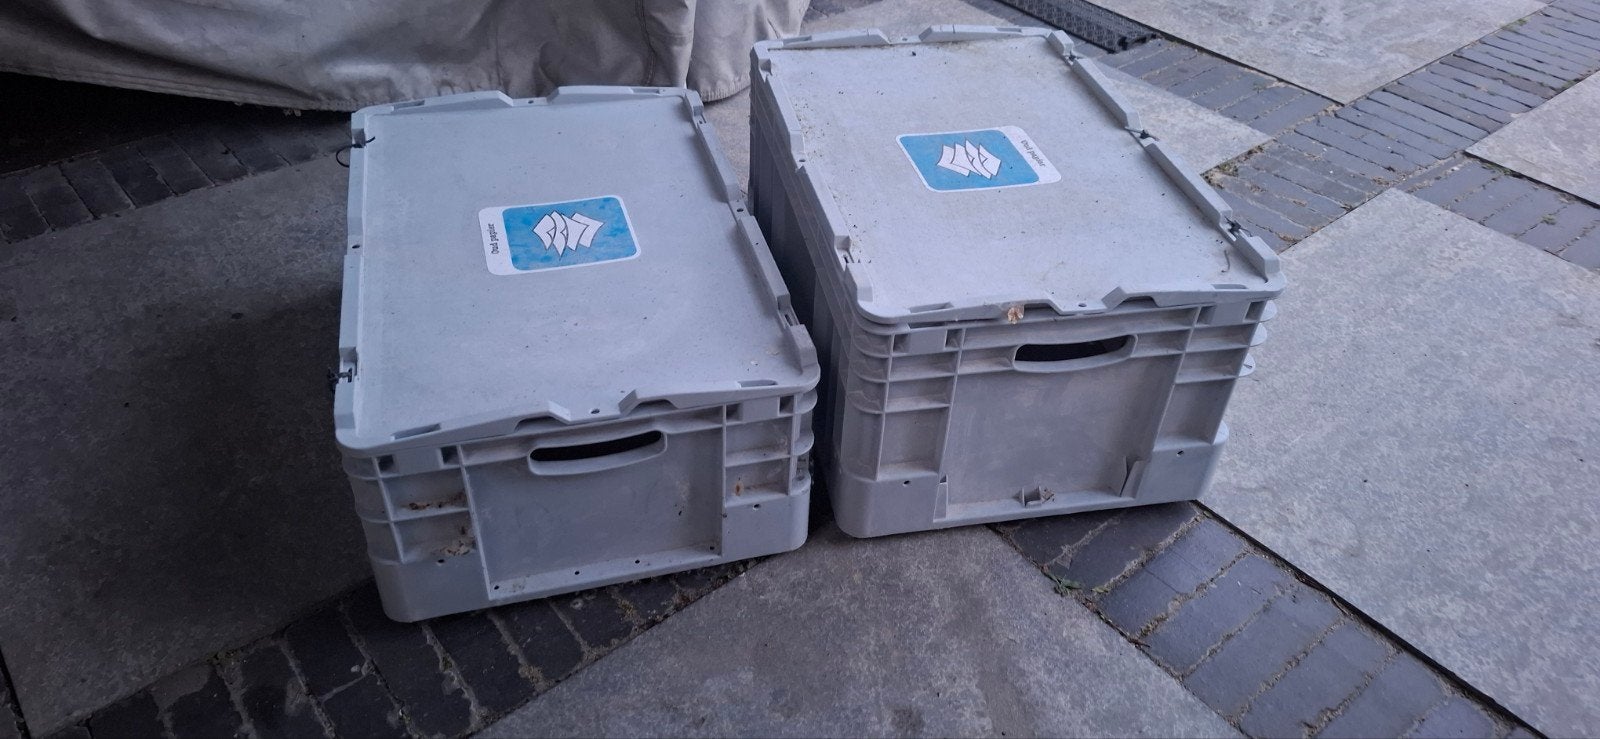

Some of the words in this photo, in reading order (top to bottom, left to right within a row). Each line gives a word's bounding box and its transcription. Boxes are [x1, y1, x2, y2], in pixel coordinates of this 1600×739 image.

[1021, 139, 1033, 150] Oud
[1027, 151, 1046, 167] papier
[487, 223, 499, 242] papier
[490, 242, 499, 254] Oud
